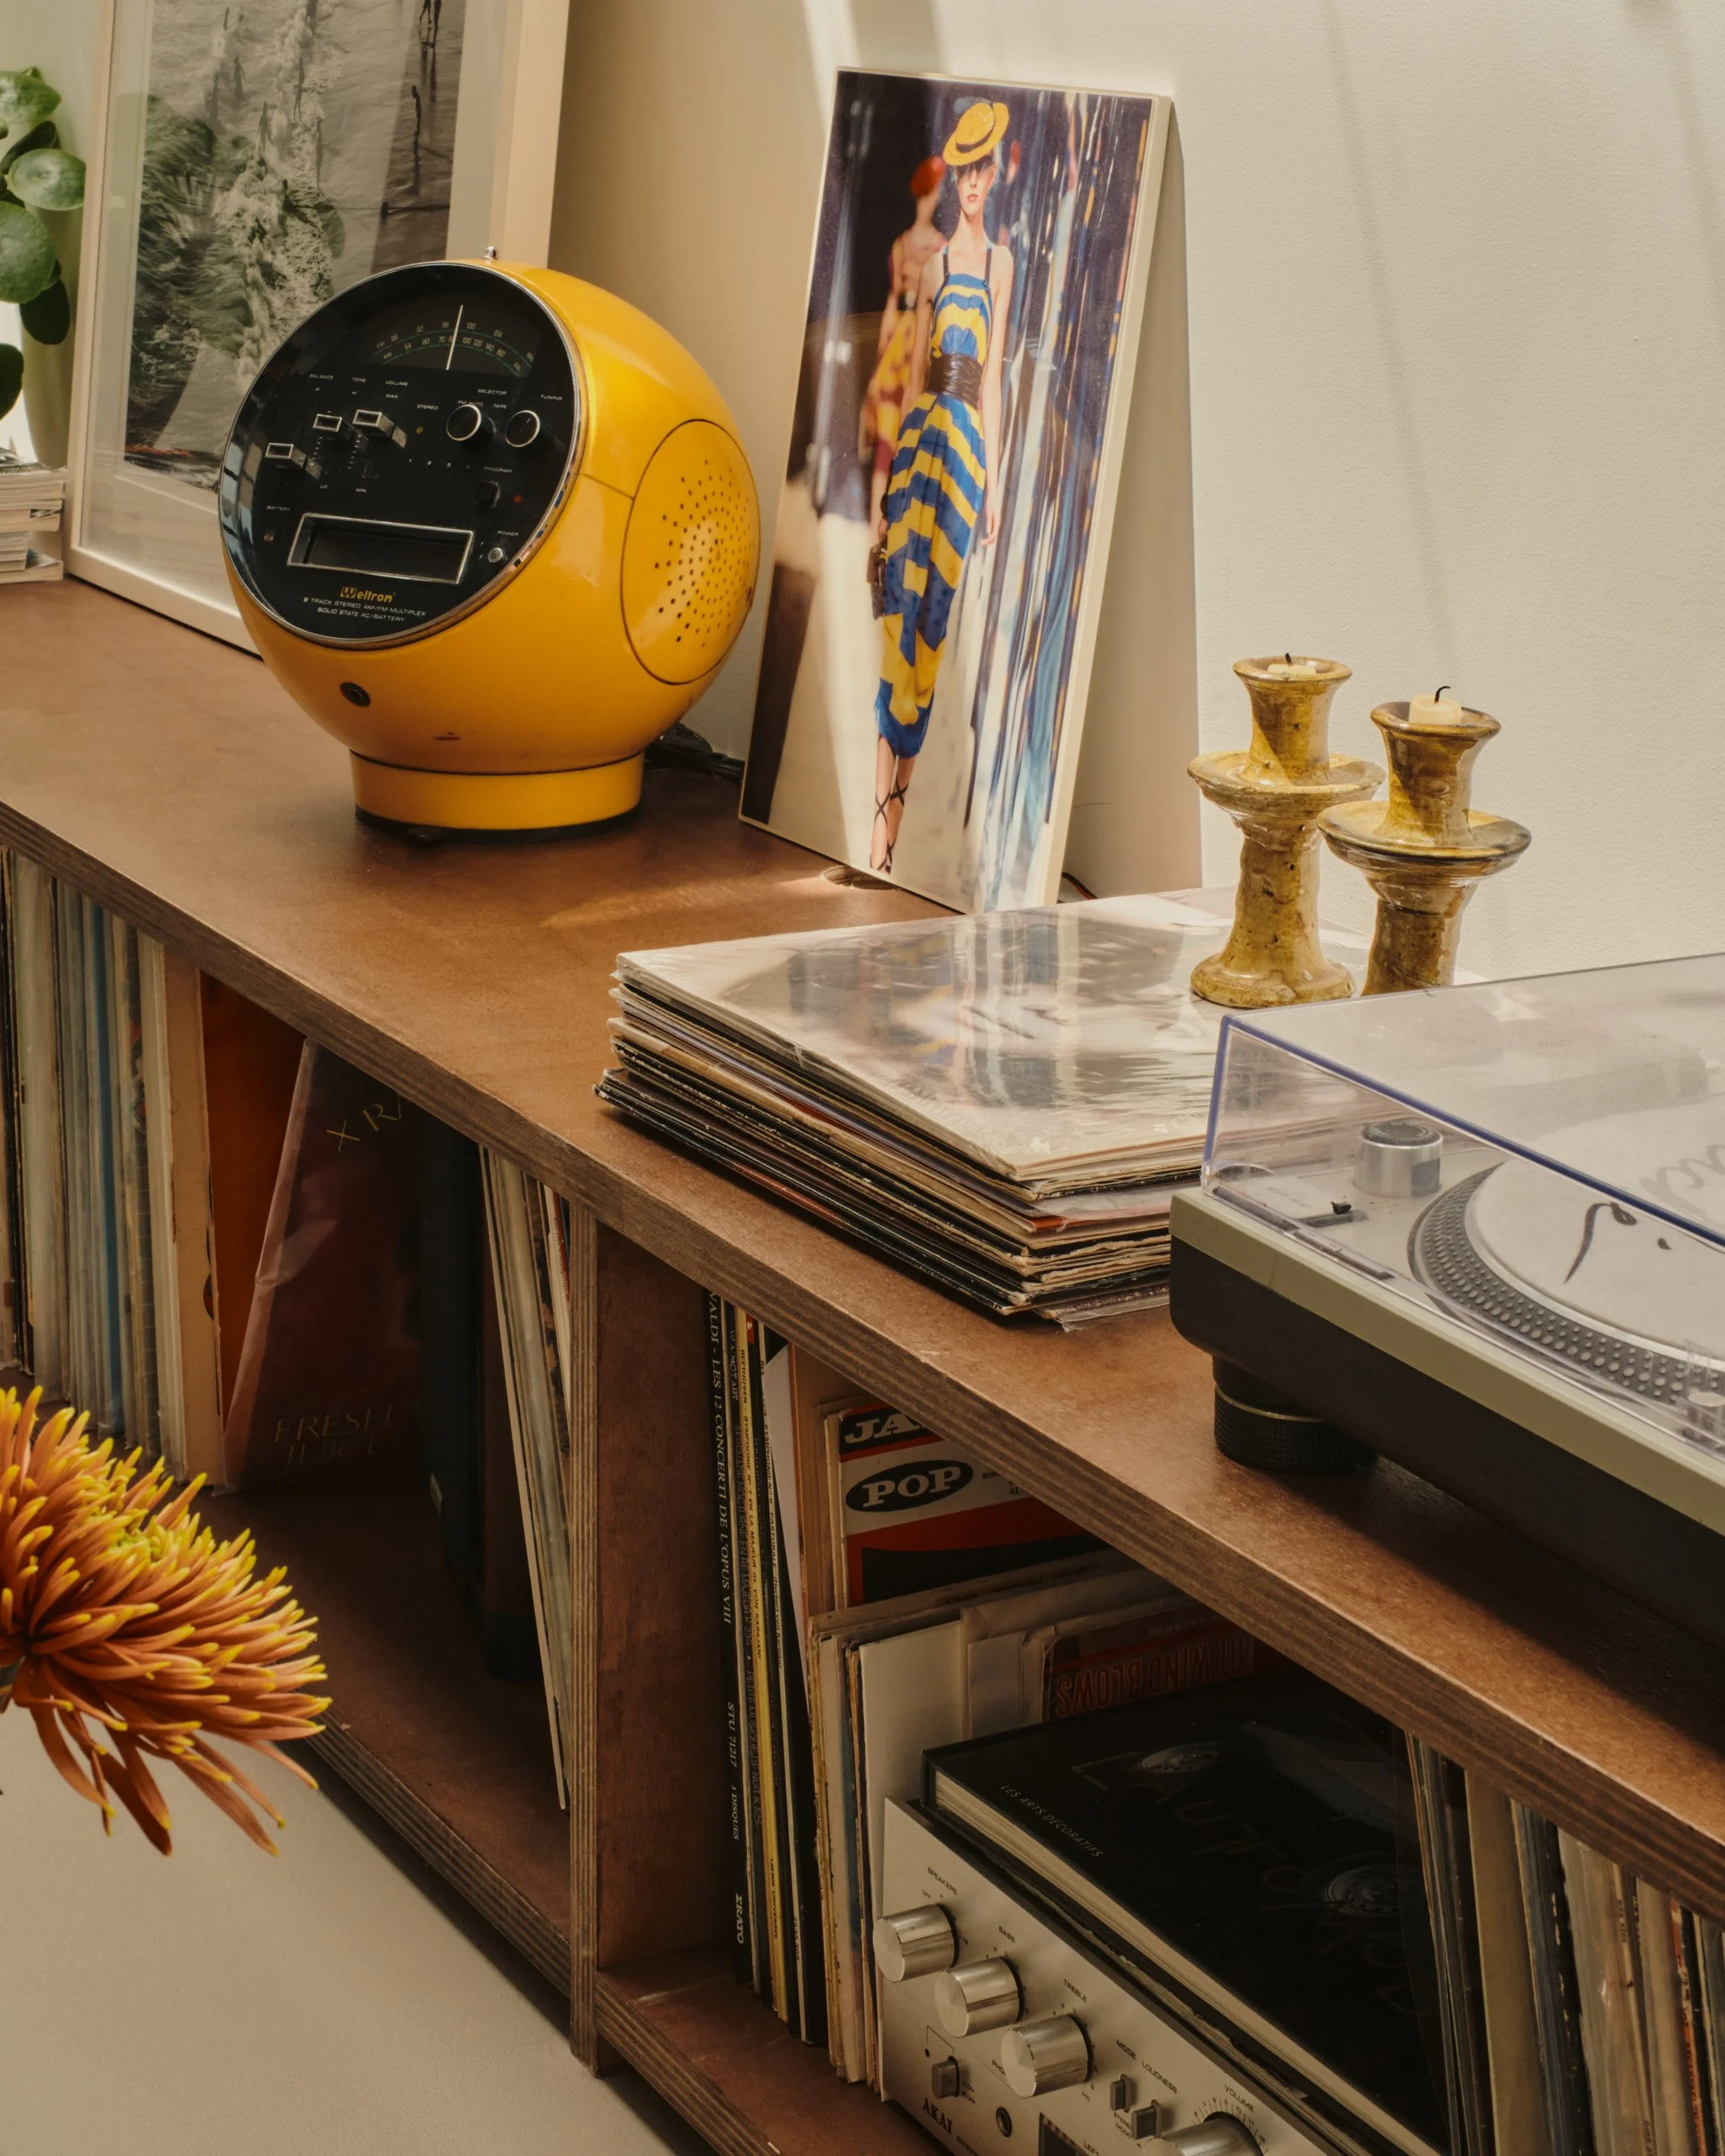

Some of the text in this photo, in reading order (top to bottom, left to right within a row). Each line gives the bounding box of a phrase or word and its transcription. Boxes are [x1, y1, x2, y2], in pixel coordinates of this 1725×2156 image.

[311, 598, 333, 607] TRACK
[334, 600, 362, 609] STEREO
[389, 607, 427, 617] MULTIPLEX
[339, 587, 394, 604] Weltron
[360, 613, 405, 623] AC/BATTERY
[712, 1360, 722, 1389] LES
[714, 1395, 723, 1409] 12
[275, 1405, 392, 1443] FRESH
[844, 1413, 923, 1444] JA
[715, 1414, 728, 1500] CONCERTI
[862, 1466, 962, 1508] POP
[718, 1504, 728, 1529] DE
[720, 1532, 731, 1590] L'OPUS
[722, 1595, 732, 1625] VIII
[1054, 1658, 1144, 1719] BLOWS
[728, 1702, 738, 1768] STU 71217
[1000, 1785, 1022, 1797] LES
[1017, 1797, 1046, 1815] ARTS
[731, 1793, 740, 1841] DISQUES
[927, 1867, 958, 1896] SPEAKERS
[735, 1892, 744, 1944] ERATO
[998, 1925, 1015, 1944] BASS
[1063, 1978, 1087, 2003] TREBLE
[1116, 2039, 1136, 2061] MODE
[1142, 2060, 1177, 2095] LOUDNESS
[1224, 2083, 1254, 2113] VOLUME
[922, 2098, 952, 2135] AKAI
